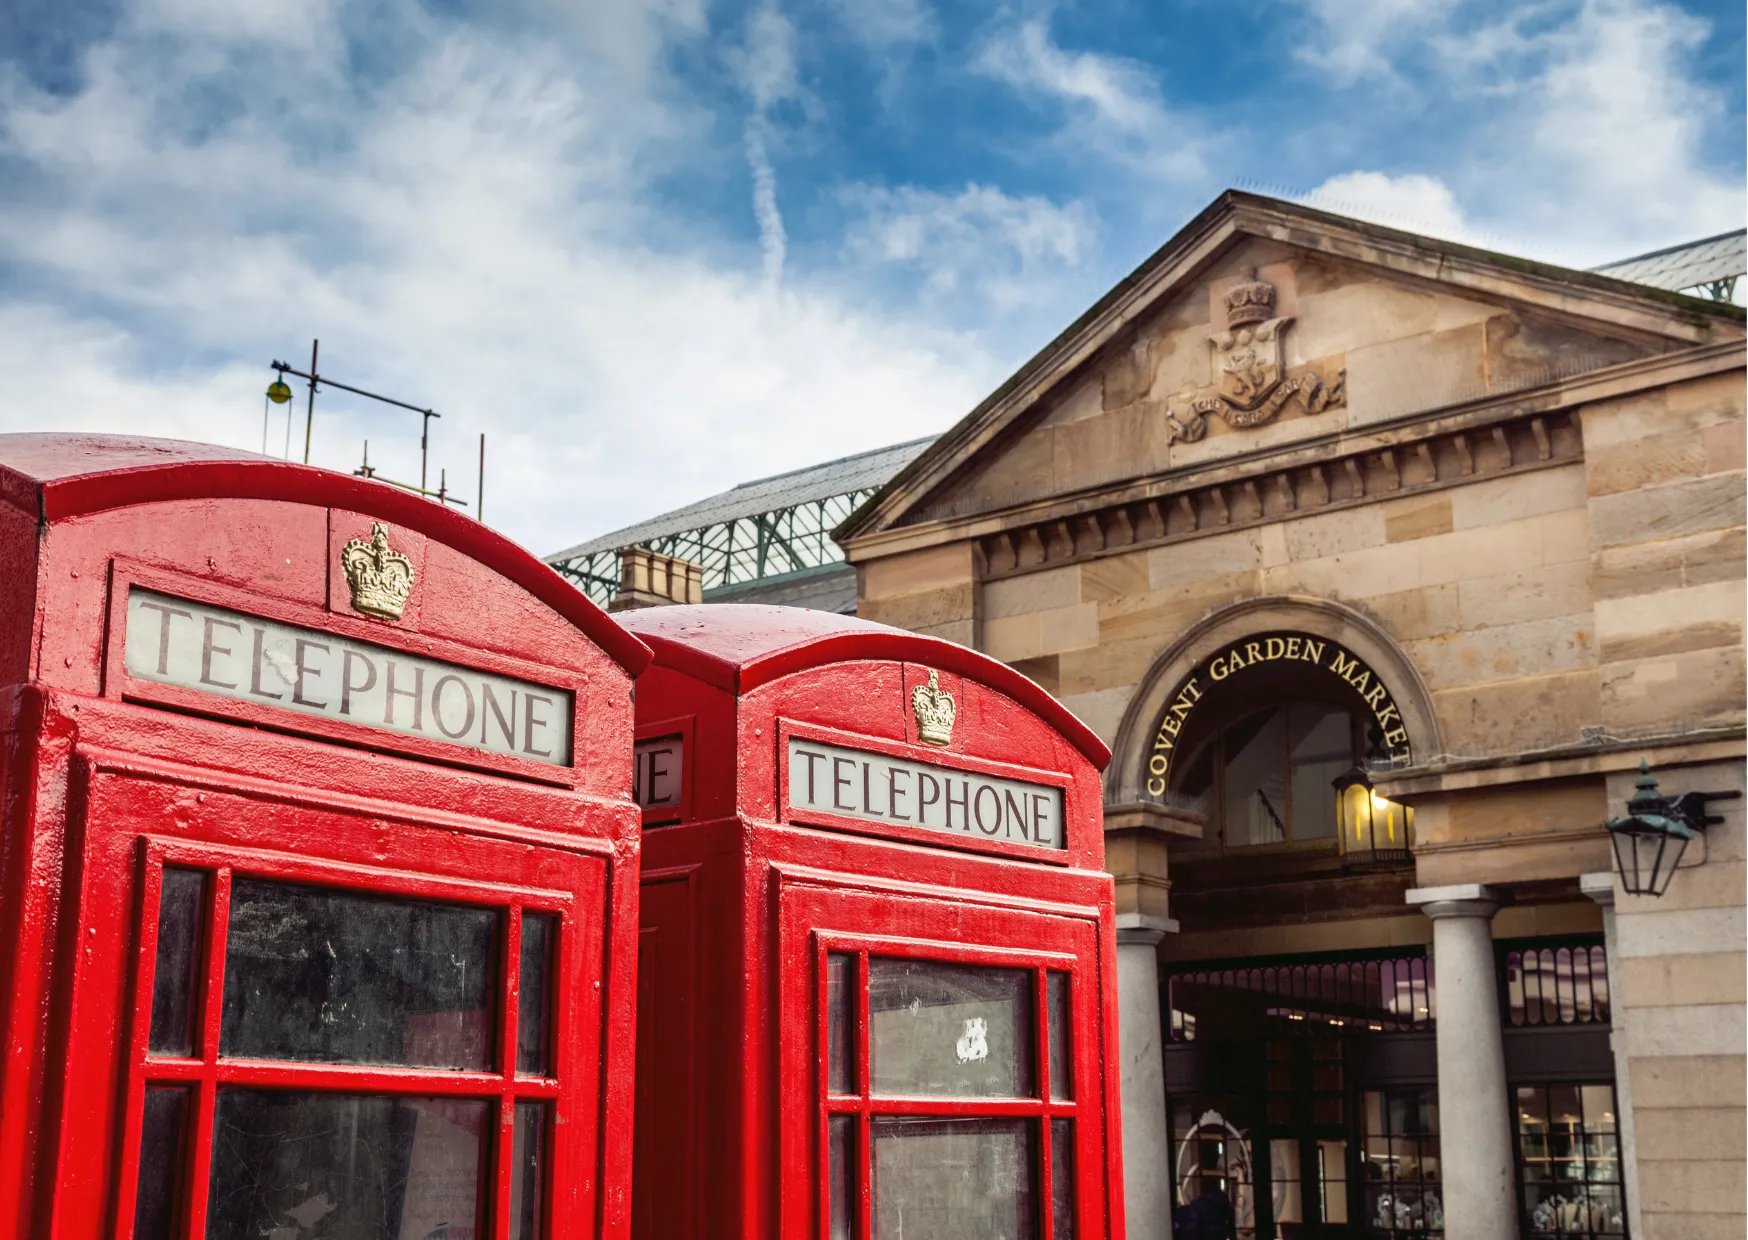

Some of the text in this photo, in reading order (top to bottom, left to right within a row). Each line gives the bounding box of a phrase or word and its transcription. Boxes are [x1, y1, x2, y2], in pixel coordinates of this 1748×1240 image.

[139, 601, 554, 757] TELEPHONE
[1147, 637, 1412, 797] COVENT GARDEN MARKET
[795, 749, 1053, 843] TELEPHONE
